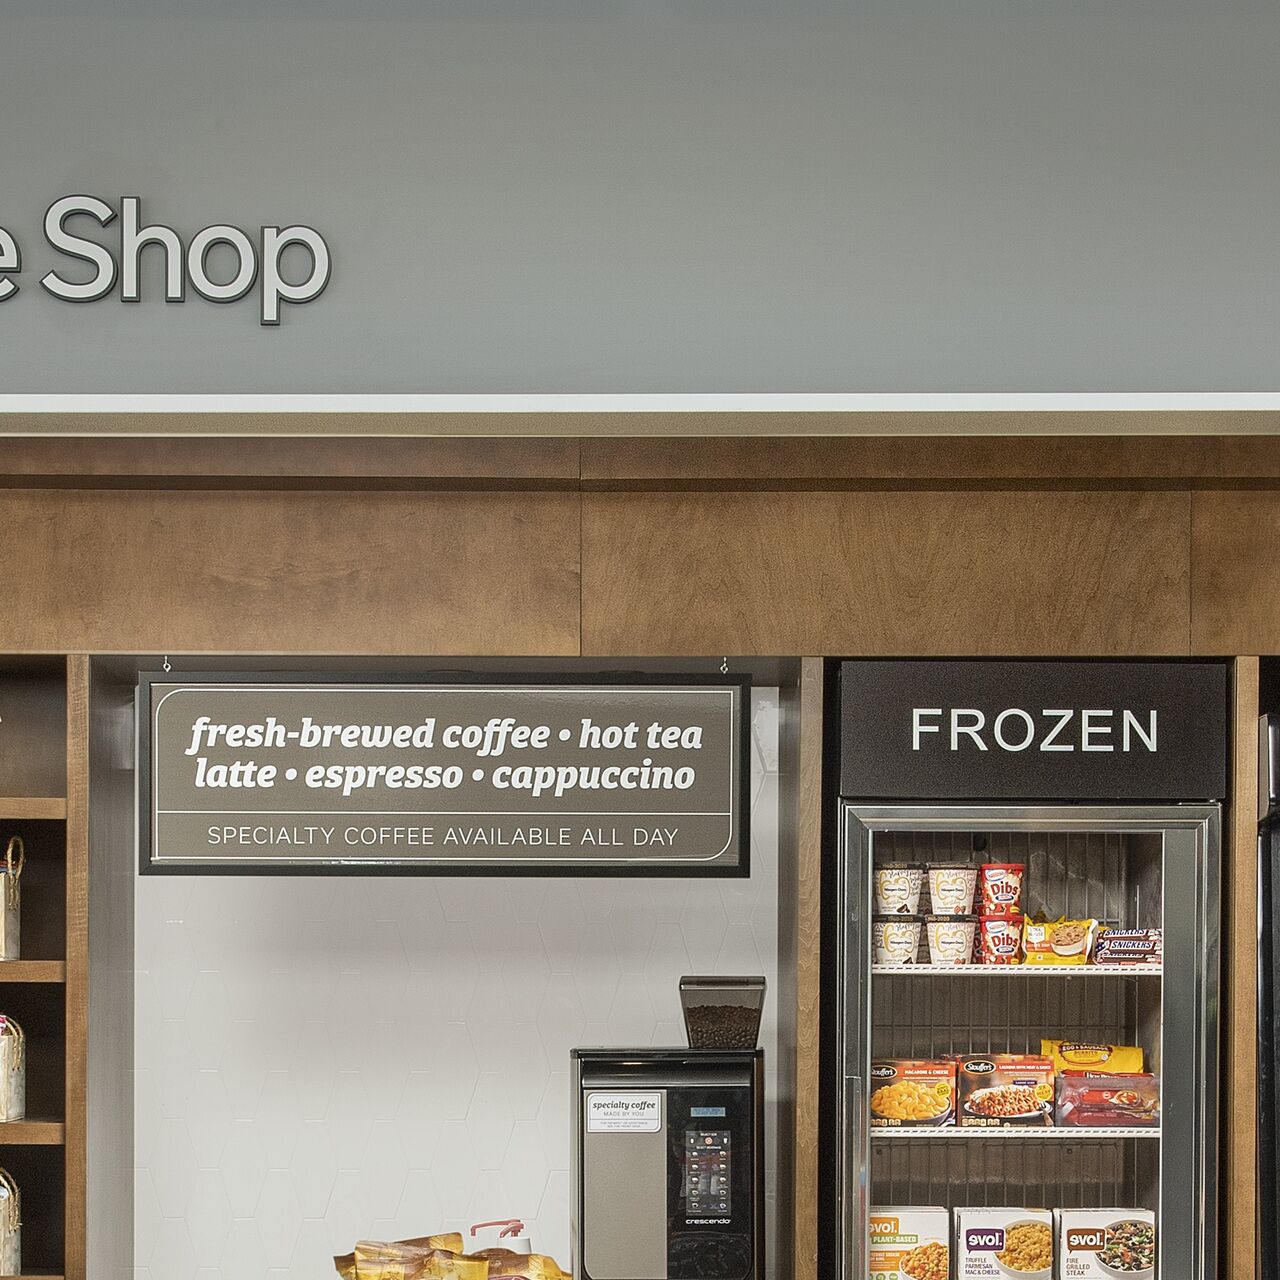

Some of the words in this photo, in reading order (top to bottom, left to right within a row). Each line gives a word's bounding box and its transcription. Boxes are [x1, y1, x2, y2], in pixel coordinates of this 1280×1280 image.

[39, 193, 333, 327] Shop
[185, 715, 436, 756] fresh-brewed
[441, 718, 550, 759] coffee
[578, 719, 639, 750] hot
[647, 722, 704, 750] tea
[912, 708, 1159, 753] FROZEN
[194, 758, 277, 789] latte
[304, 763, 464, 797] espresso
[491, 757, 696, 798] cappuccino
[207, 825, 335, 847] SPECIALTY
[343, 826, 435, 846] COFFEE
[442, 826, 573, 847] AVAILABLE
[580, 827, 624, 848] ALL
[633, 827, 680, 848] DAY
[990, 881, 1019, 898] Dibs
[1111, 939, 1153, 949] SNICKERS
[966, 1062, 996, 1073] Stouffer's
[592, 1099, 630, 1111] specialty
[630, 1100, 656, 1110] coffee
[685, 1217, 731, 1225] crescendo
[873, 1235, 917, 1243] PLANT-BASED
[968, 1232, 1003, 1247] evol.
